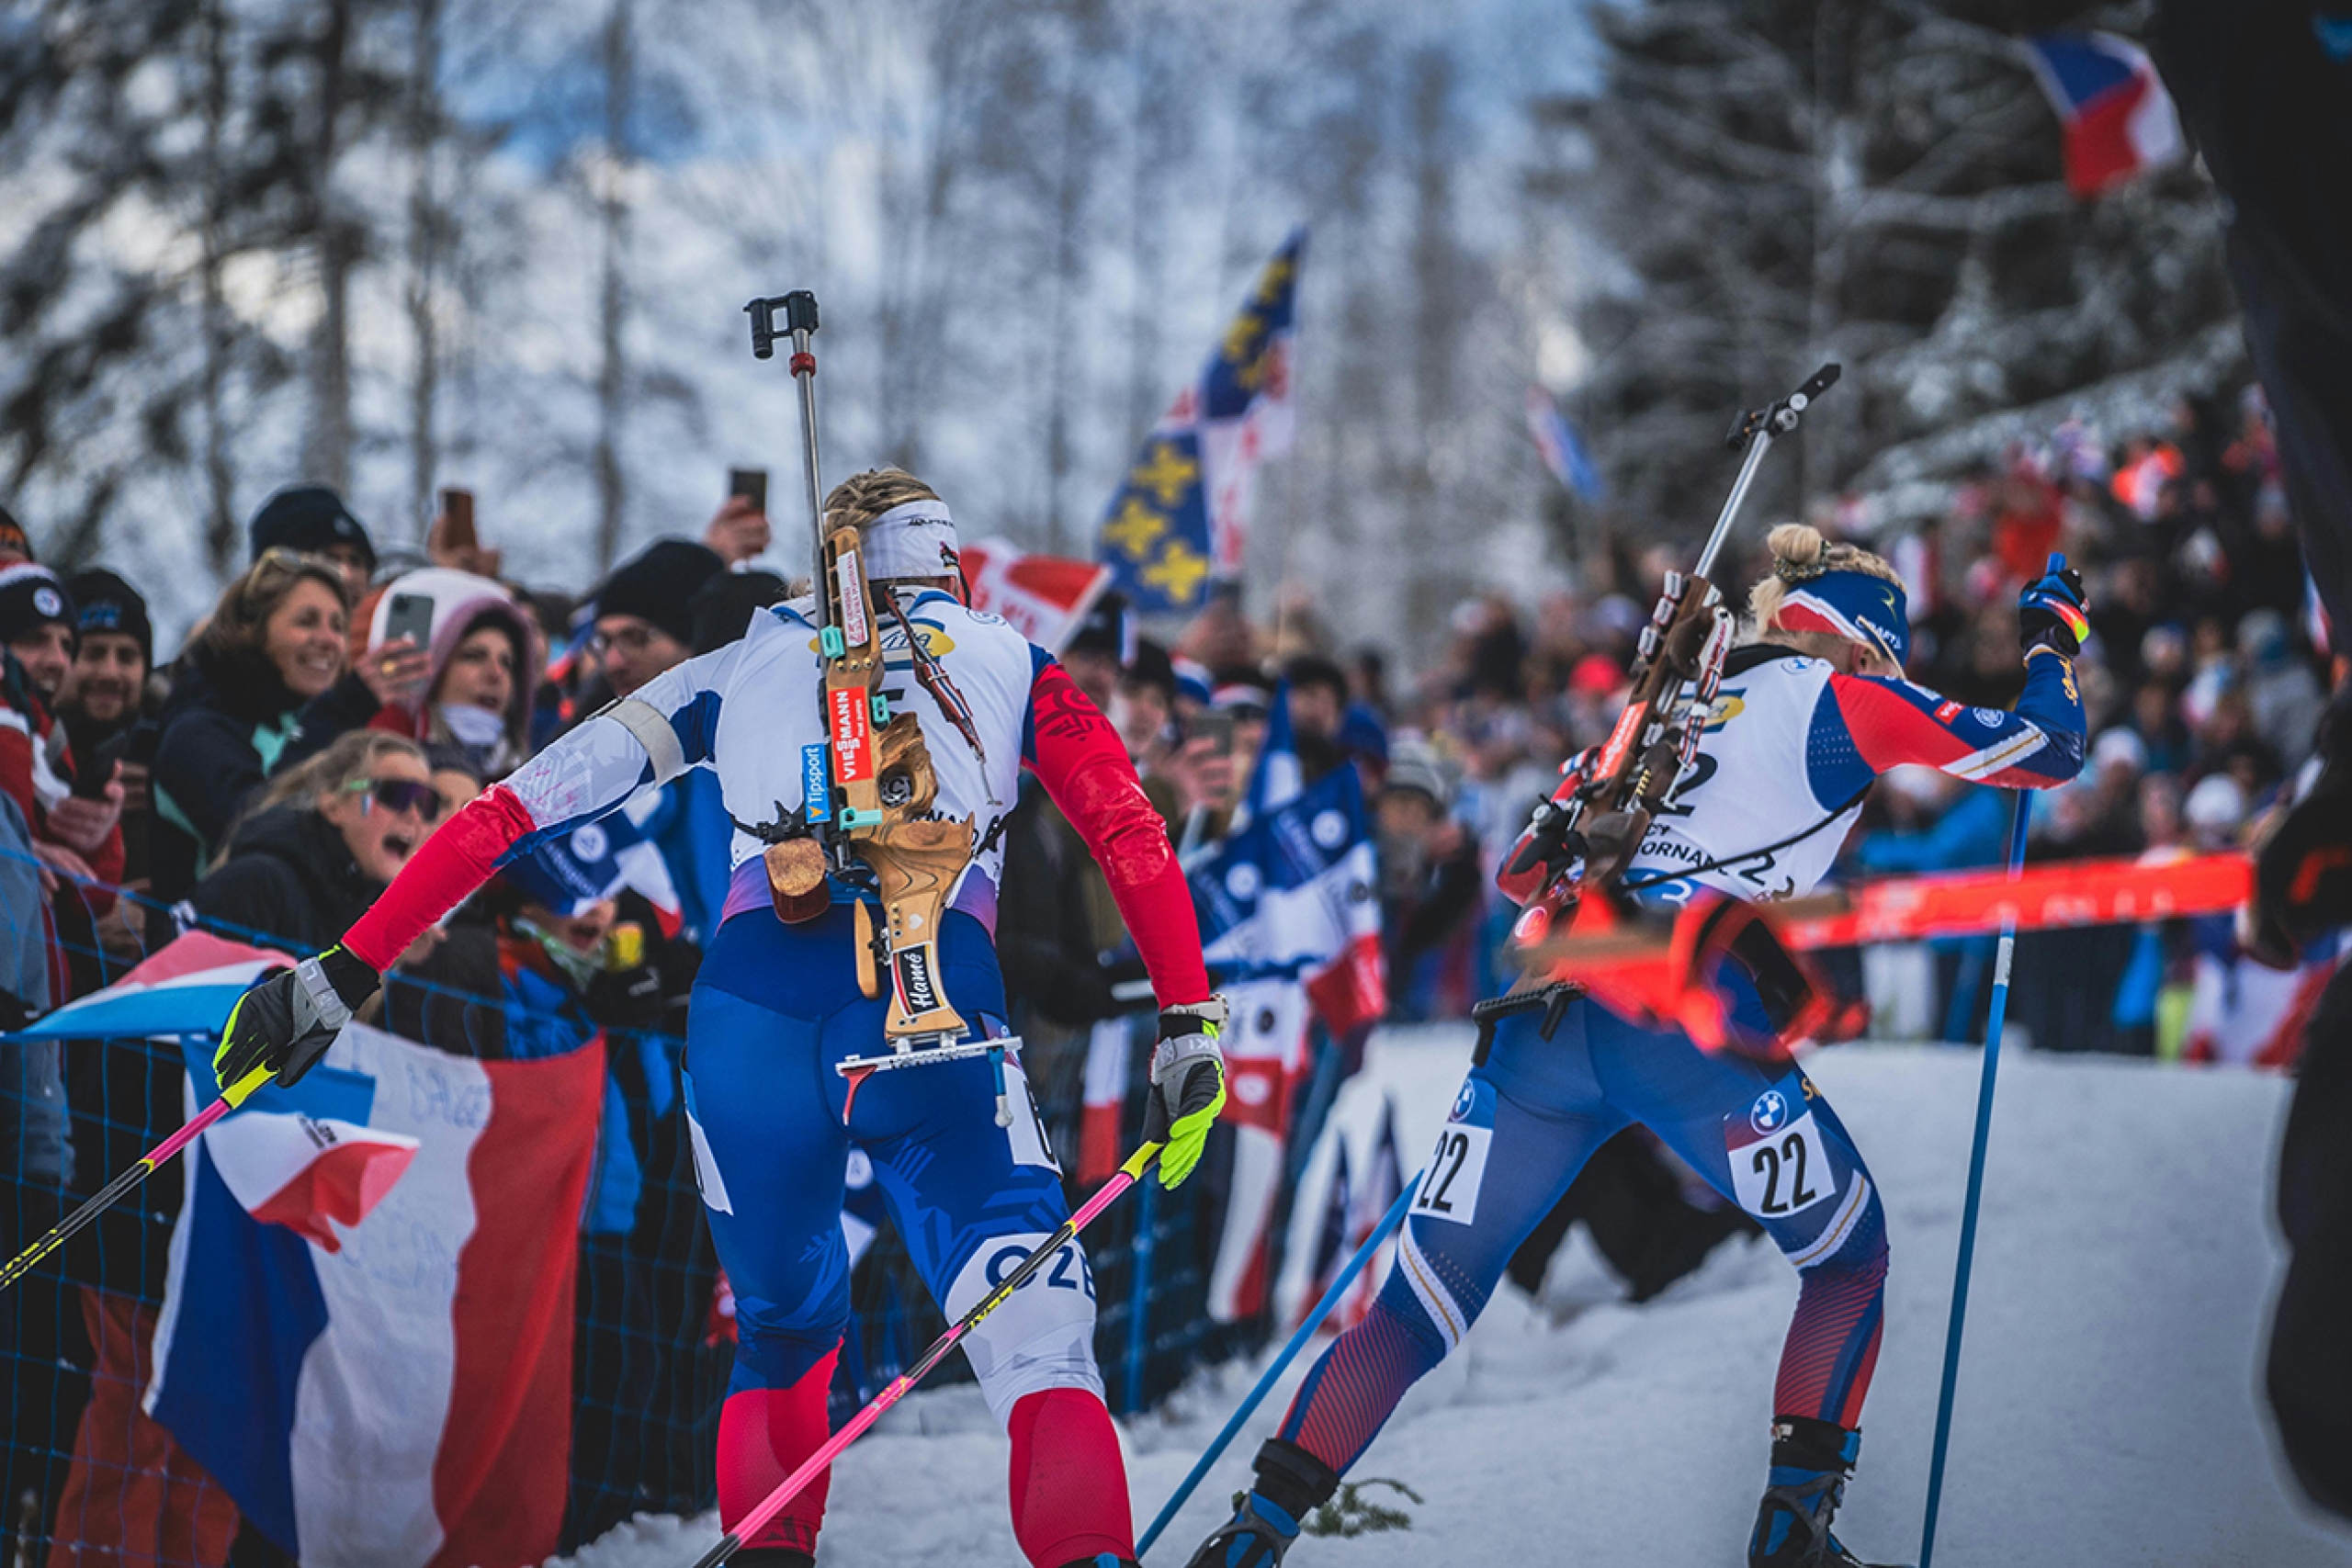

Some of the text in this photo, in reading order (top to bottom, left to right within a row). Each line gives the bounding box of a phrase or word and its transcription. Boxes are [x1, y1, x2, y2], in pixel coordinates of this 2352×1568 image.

[806, 748, 823, 804] Tipsport
[904, 952, 934, 1008] Hamé
[1416, 1129, 1469, 1213] 22
[1752, 1131, 1816, 1213] 22
